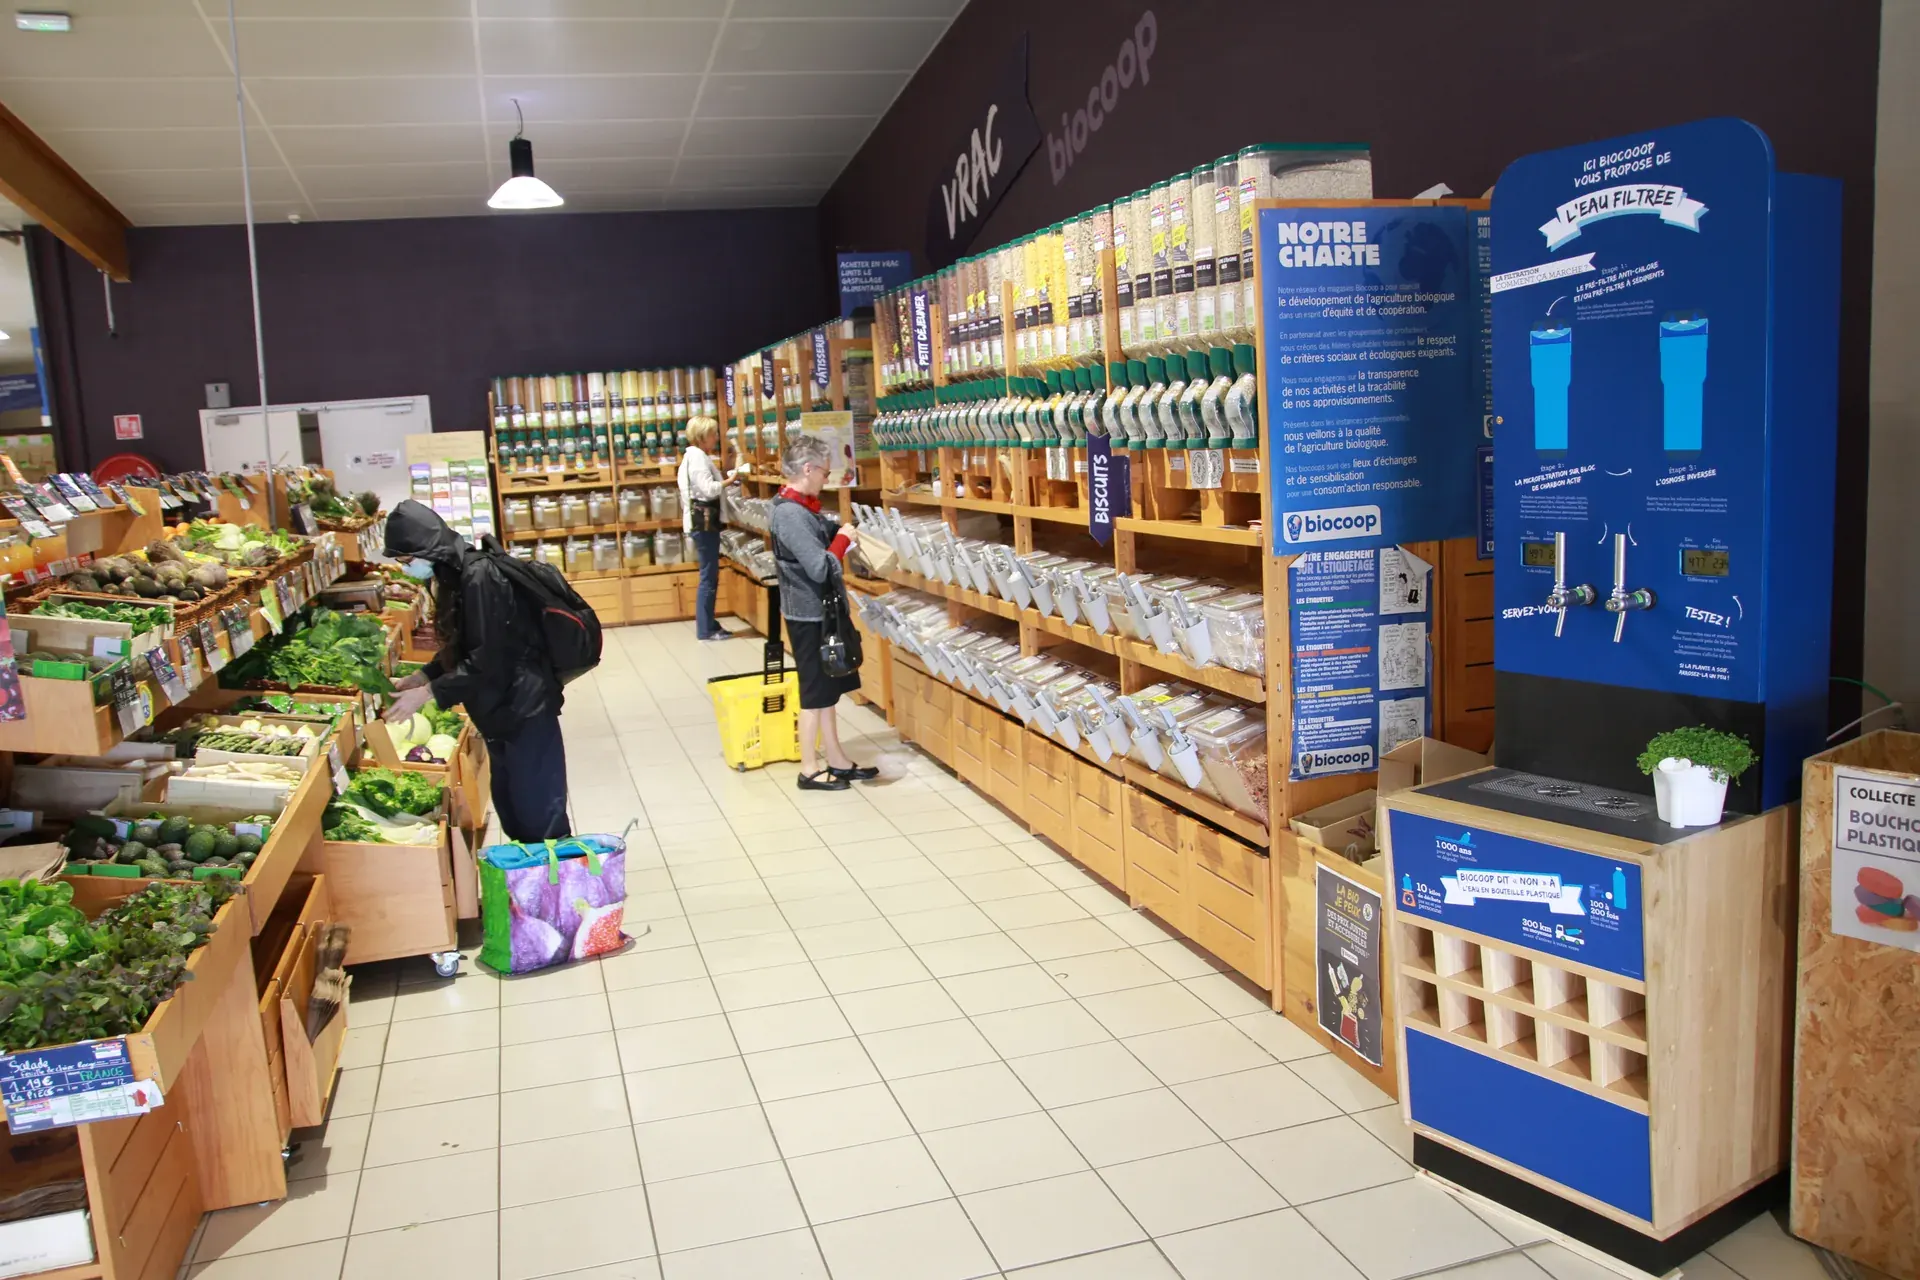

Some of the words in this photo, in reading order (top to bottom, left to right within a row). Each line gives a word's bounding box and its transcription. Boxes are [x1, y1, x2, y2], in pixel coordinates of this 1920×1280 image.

[1047, 10, 1158, 186] biocoop
[1584, 159, 1596, 171] ICI
[1600, 142, 1655, 166] BIOCOOOP
[942, 104, 1002, 240] VRAC
[1574, 172, 1601, 187] VOUS
[1604, 159, 1652, 180] PROPOSE
[1656, 152, 1671, 165] DE
[1566, 191, 1609, 223] L'EAU
[1613, 185, 1675, 208] FILTRÉE
[1279, 222, 1366, 244] NOTRE
[1279, 244, 1380, 267] CHARTE
[1496, 274, 1535, 290] COMMENT
[1504, 268, 1539, 280] FILTRATION
[1278, 297, 1286, 306] le
[1289, 295, 1351, 306] développement
[1354, 295, 1364, 304] de
[1367, 294, 1412, 305] l'agriculture
[1415, 292, 1455, 303] biologique
[914, 294, 928, 341] DÉJEUNER
[1323, 307, 1353, 318] d'équité
[1356, 308, 1364, 316] et
[1366, 307, 1376, 315] de
[1379, 305, 1427, 316] coopération.
[1418, 336, 1424, 345] le
[1427, 335, 1456, 346] respect
[815, 333, 828, 384] PÂTISSERIE
[918, 342, 929, 366] PETIT
[1281, 355, 1291, 365] de
[1294, 353, 1325, 363] critères
[1327, 352, 1357, 362] sociaux
[1359, 351, 1367, 360] et
[1370, 350, 1416, 360] écologiques
[1418, 347, 1456, 359] exigeants.
[1358, 371, 1365, 380] la
[1368, 369, 1419, 380] transparence
[1282, 387, 1292, 397] de
[1295, 387, 1310, 395] nos
[1313, 384, 1346, 395] activités
[1348, 384, 1356, 393] et
[1358, 383, 1365, 392] la
[1368, 381, 1406, 393] traçabilité
[1283, 400, 1293, 409] de
[1296, 400, 1310, 408] nos
[1313, 394, 1394, 408] approvisionnements.
[1284, 432, 1303, 441] nous
[1306, 430, 1335, 439] veillons
[1338, 428, 1343, 437] à
[1346, 428, 1353, 437] la
[1355, 425, 1381, 436] qualité
[1285, 444, 1295, 454] de
[1297, 441, 1343, 454] l'agriculture
[1346, 438, 1388, 449] biologique.
[1353, 458, 1371, 468] lieux
[1374, 456, 1417, 466] d'échanges
[1580, 464, 1595, 473] BLOC
[1286, 476, 1294, 486] et
[1297, 475, 1307, 484] de
[1310, 471, 1364, 483] sensibilisation
[1314, 482, 1370, 495] consom'action
[1372, 478, 1422, 492] responsable.
[1656, 475, 1685, 486] L'OSMOSE
[1094, 454, 1109, 524] BISCUITS
[1305, 513, 1377, 533] biocoop
[1324, 550, 1374, 560] ENGAGEMENT
[1685, 606, 1723, 625] TESTEZ
[1315, 751, 1370, 767] biocoop
[1850, 787, 1916, 807] COLLECTE
[1848, 829, 1920, 853] PLASTIQ
[1460, 873, 1494, 883] BIOCOOP
[1497, 876, 1509, 884] DIT
[1337, 883, 1345, 897] LA
[1347, 889, 1359, 904] BIO
[1416, 882, 1427, 893] 10
[1429, 888, 1441, 897] kilos
[1492, 888, 1524, 896] BOUTEILLE
[1526, 890, 1560, 898] PLASTIQUE
[1424, 894, 1441, 903] déchets
[1590, 900, 1604, 909] 100
[1327, 909, 1336, 920] DES
[1337, 914, 1349, 927] PRIX
[1590, 907, 1605, 917] 200
[1607, 911, 1619, 920] fois
[1522, 918, 1538, 928] 300
[1540, 922, 1552, 933] km
[1530, 929, 1552, 938] moyenne
[9, 1058, 48, 1073] Salade
[80, 1066, 124, 1081] FRANCE
